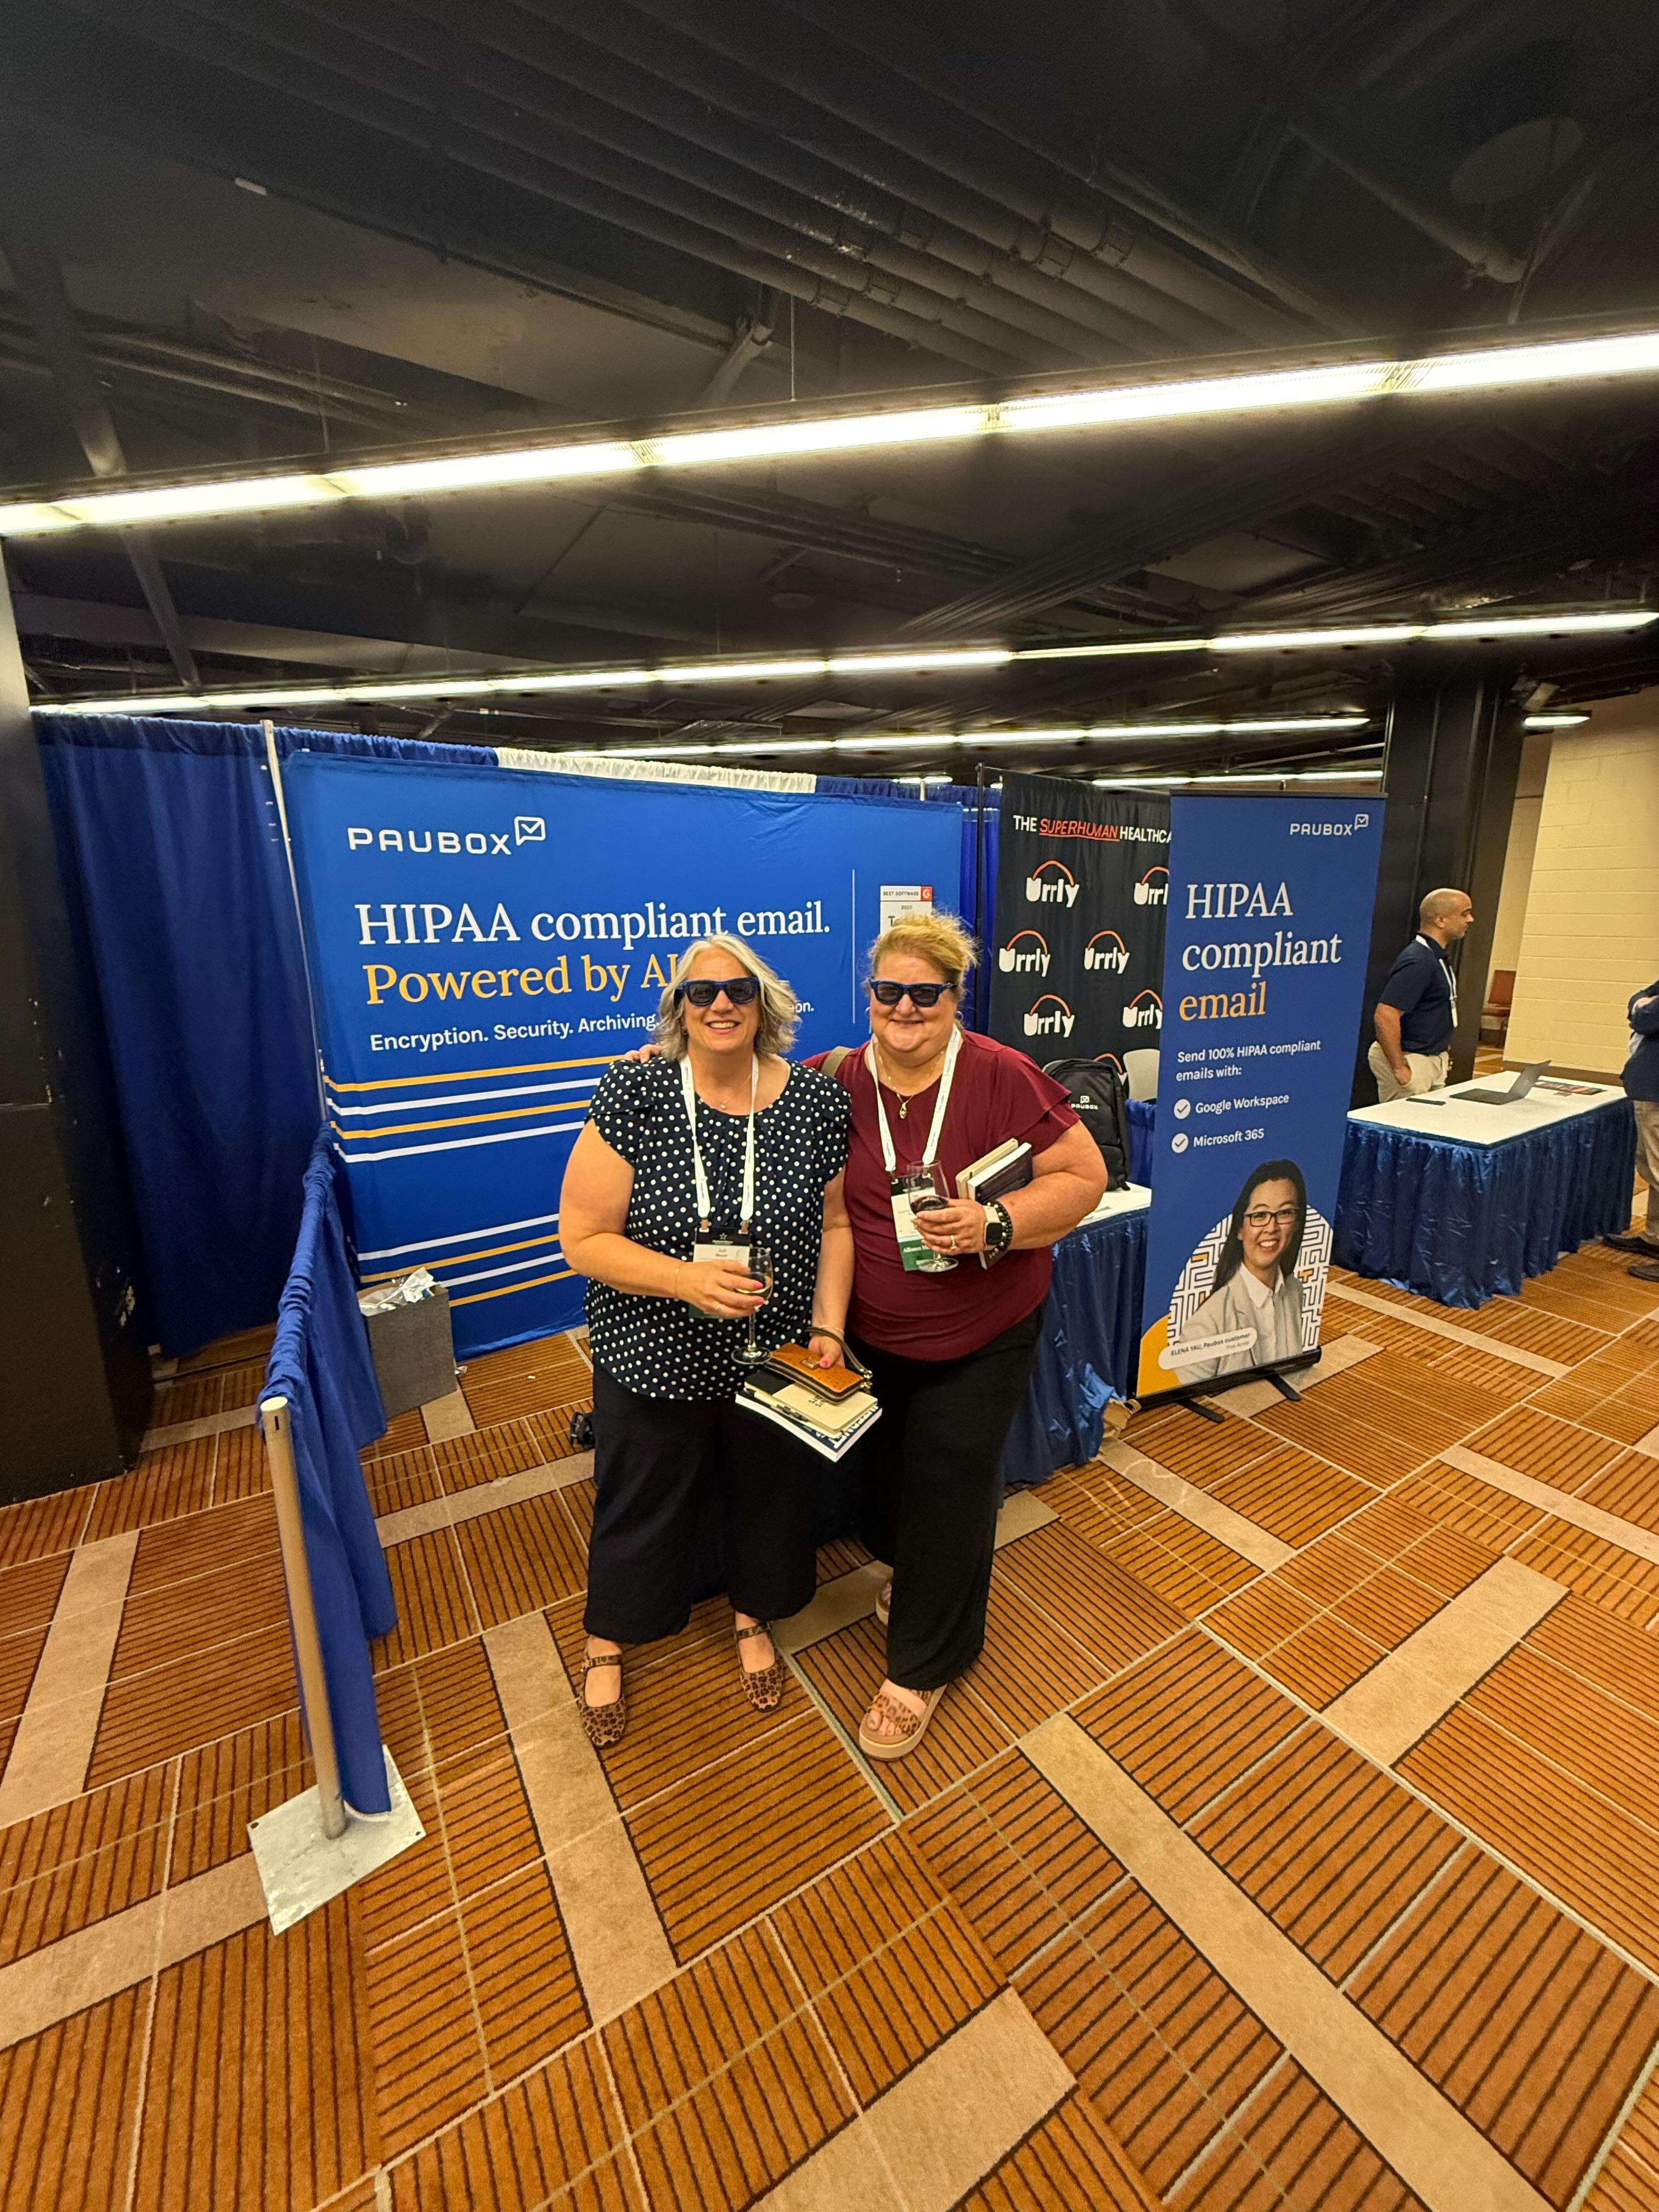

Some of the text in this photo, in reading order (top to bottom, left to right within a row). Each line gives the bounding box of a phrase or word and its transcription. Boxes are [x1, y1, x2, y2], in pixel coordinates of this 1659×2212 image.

[1013, 815, 1037, 832] THE
[1040, 818, 1118, 839] SUPERHUMAN
[1290, 823, 1352, 836] PAUBOX
[348, 827, 511, 855] PAUBOX
[1026, 878, 1079, 907] Urrly
[1186, 882, 1293, 919] HIPAA
[354, 900, 830, 950] HIPAA compliant email.
[998, 948, 1051, 977] Urrly
[1084, 947, 1130, 974] Urrly
[1182, 931, 1342, 978] compliant
[363, 953, 679, 1004] Powered by AI
[1180, 981, 1266, 1022] email
[370, 1013, 660, 1052] Encryption. Security. Archiving.
[1024, 1011, 1075, 1037] Urrly
[1177, 1040, 1321, 1063] Send 100% HIPAA compliant
[1176, 1064, 1242, 1081] emails with:
[1195, 1094, 1289, 1115] Google Workspace
[1193, 1128, 1265, 1148] Microsoft 365
[1171, 1347, 1189, 1356] ELENA
